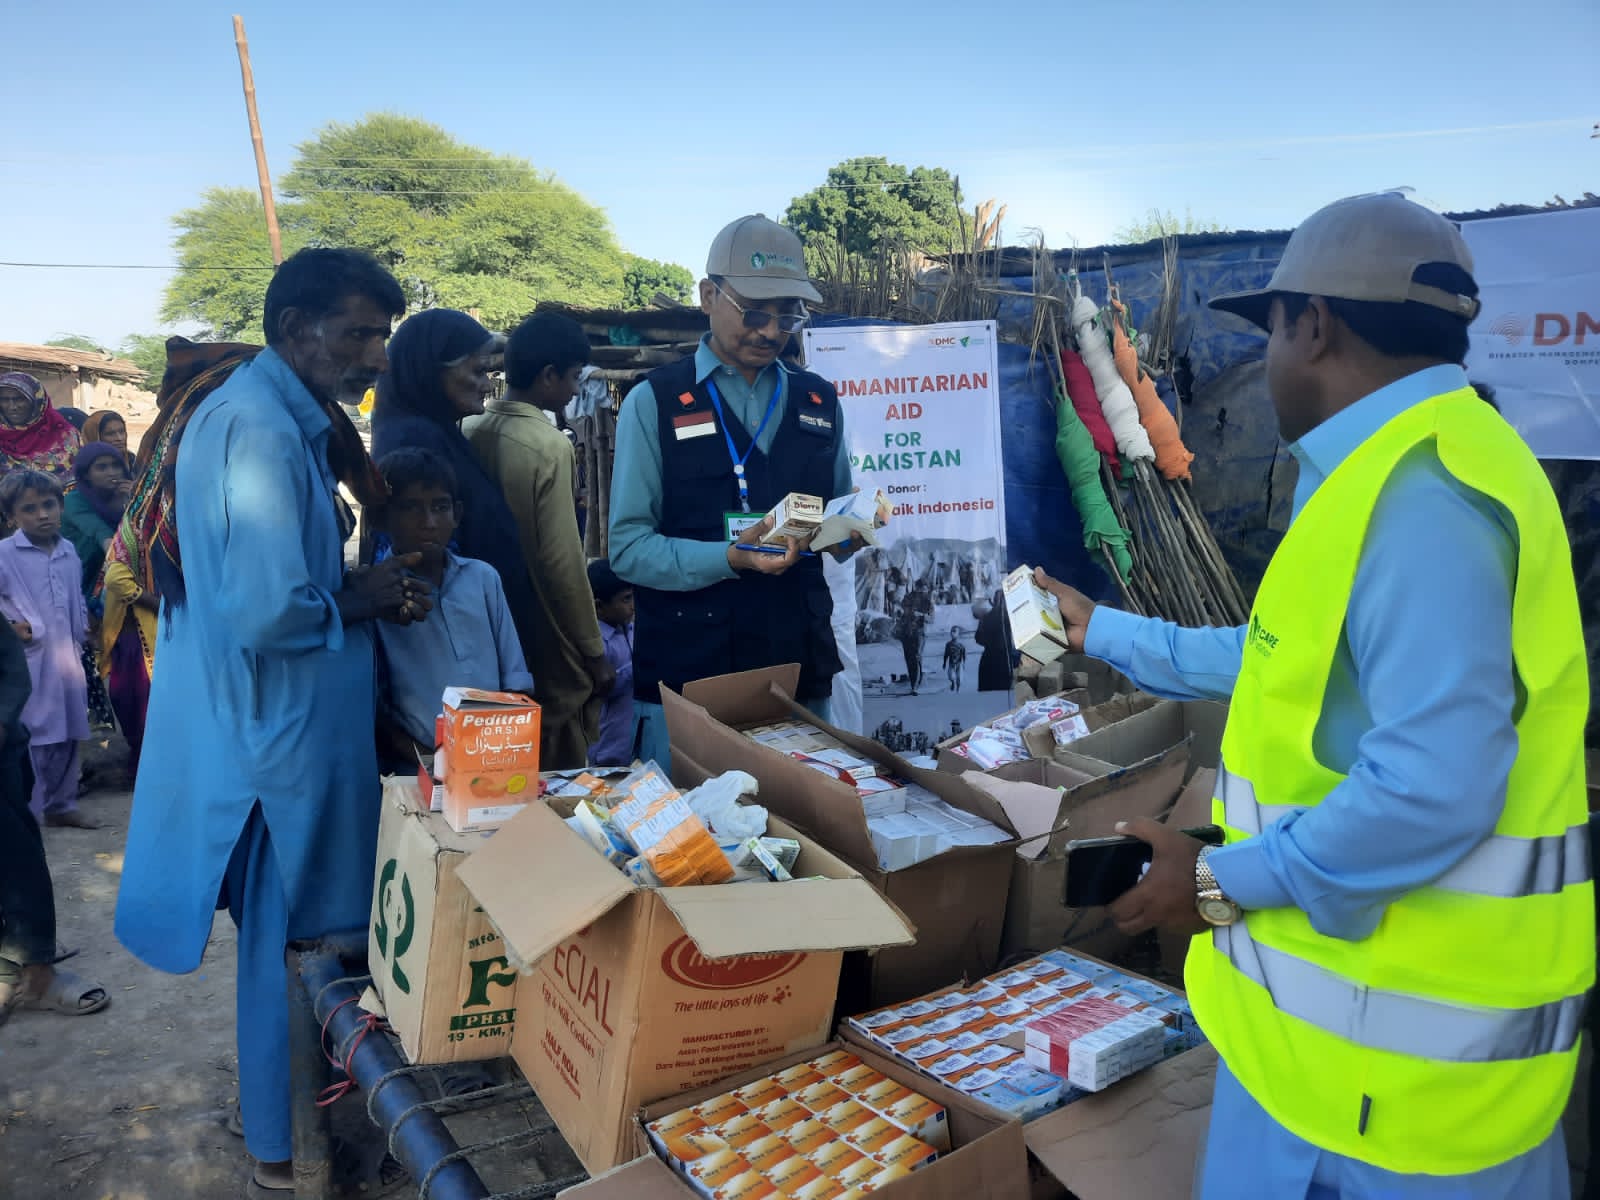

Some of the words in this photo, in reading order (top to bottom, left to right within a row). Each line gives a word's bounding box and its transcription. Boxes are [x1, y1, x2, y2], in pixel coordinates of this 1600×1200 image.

[935, 337, 956, 346] DMC
[833, 372, 988, 397] UMANITARIAN
[885, 402, 923, 421] AID
[884, 431, 922, 449] FOR
[887, 484, 921, 494] Donor
[891, 503, 915, 516] aik
[918, 497, 995, 514] Indonesia
[462, 711, 532, 728] Peditral
[554, 944, 614, 1037] ECIAL
[674, 1001, 694, 1013] The
[695, 998, 718, 1011] little
[718, 997, 741, 1012] joys
[741, 995, 752, 1008] of
[753, 991, 770, 1004] life
